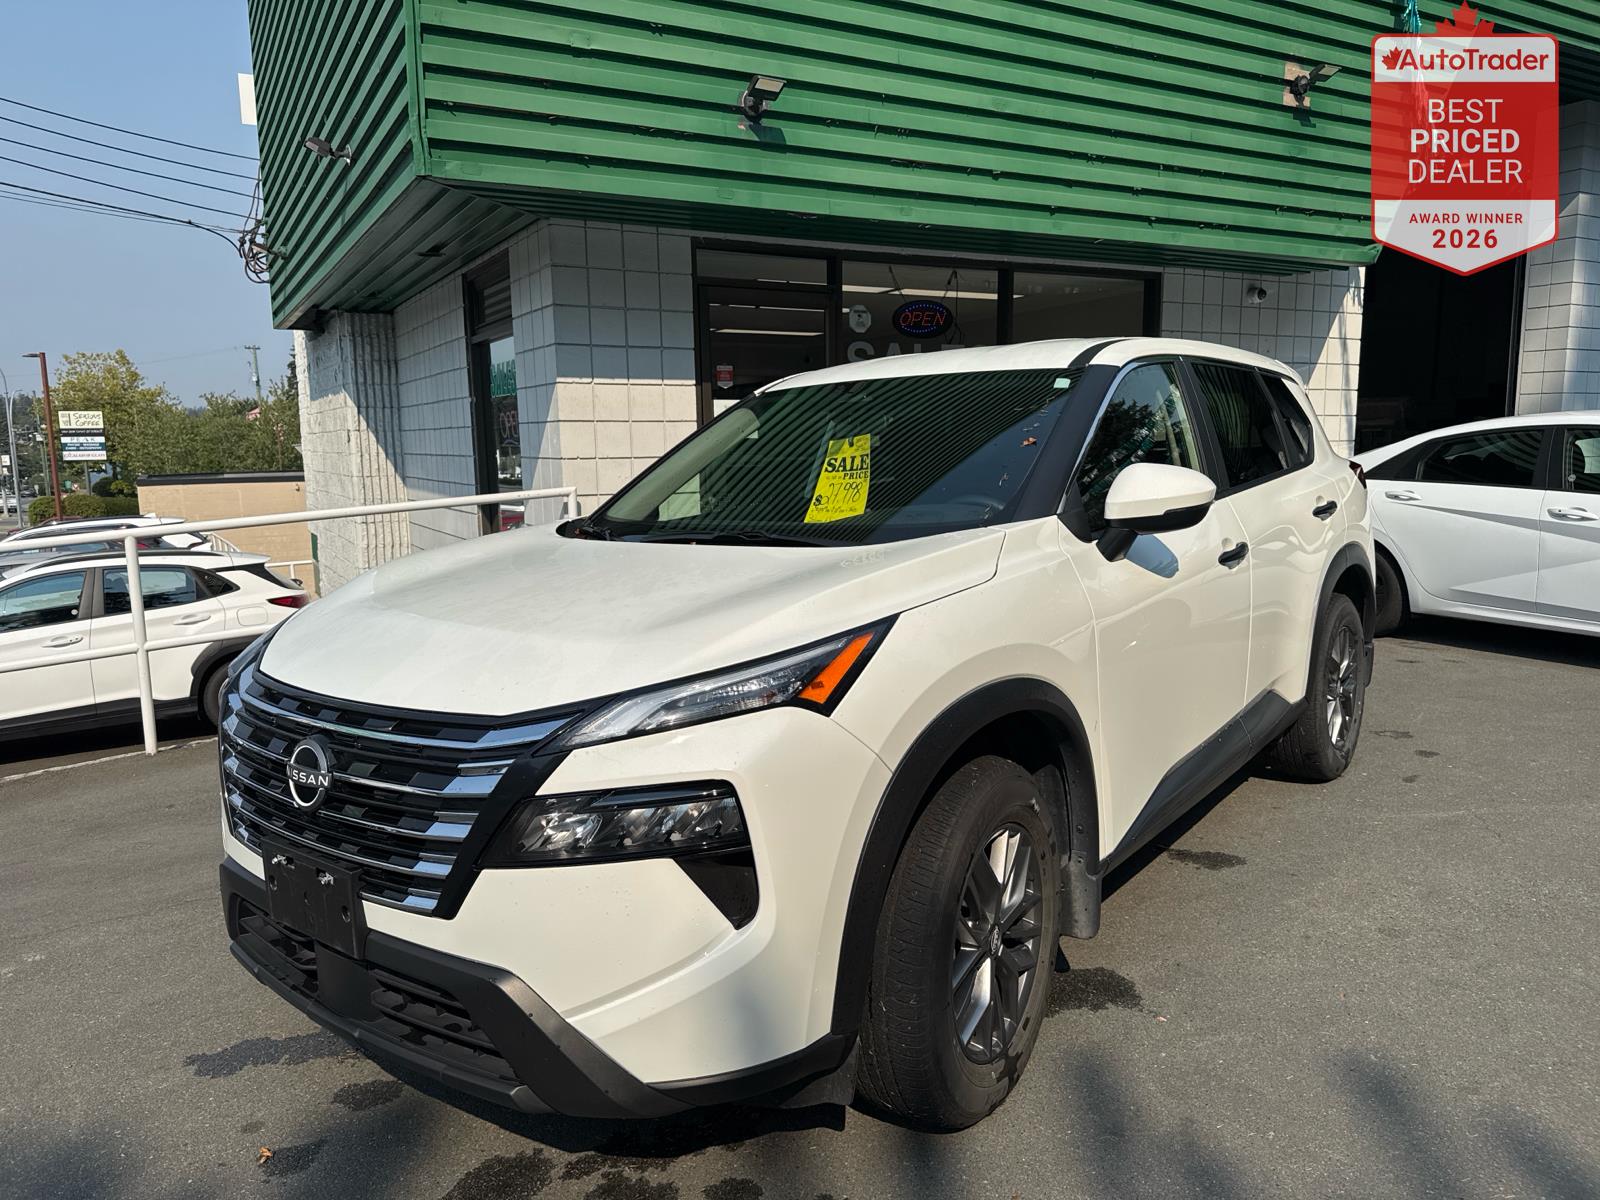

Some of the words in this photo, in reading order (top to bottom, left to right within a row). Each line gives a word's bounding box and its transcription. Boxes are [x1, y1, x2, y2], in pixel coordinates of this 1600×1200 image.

[899, 311, 946, 327] OPEN
[824, 453, 869, 473] SALE
[843, 470, 869, 480] PRICE
